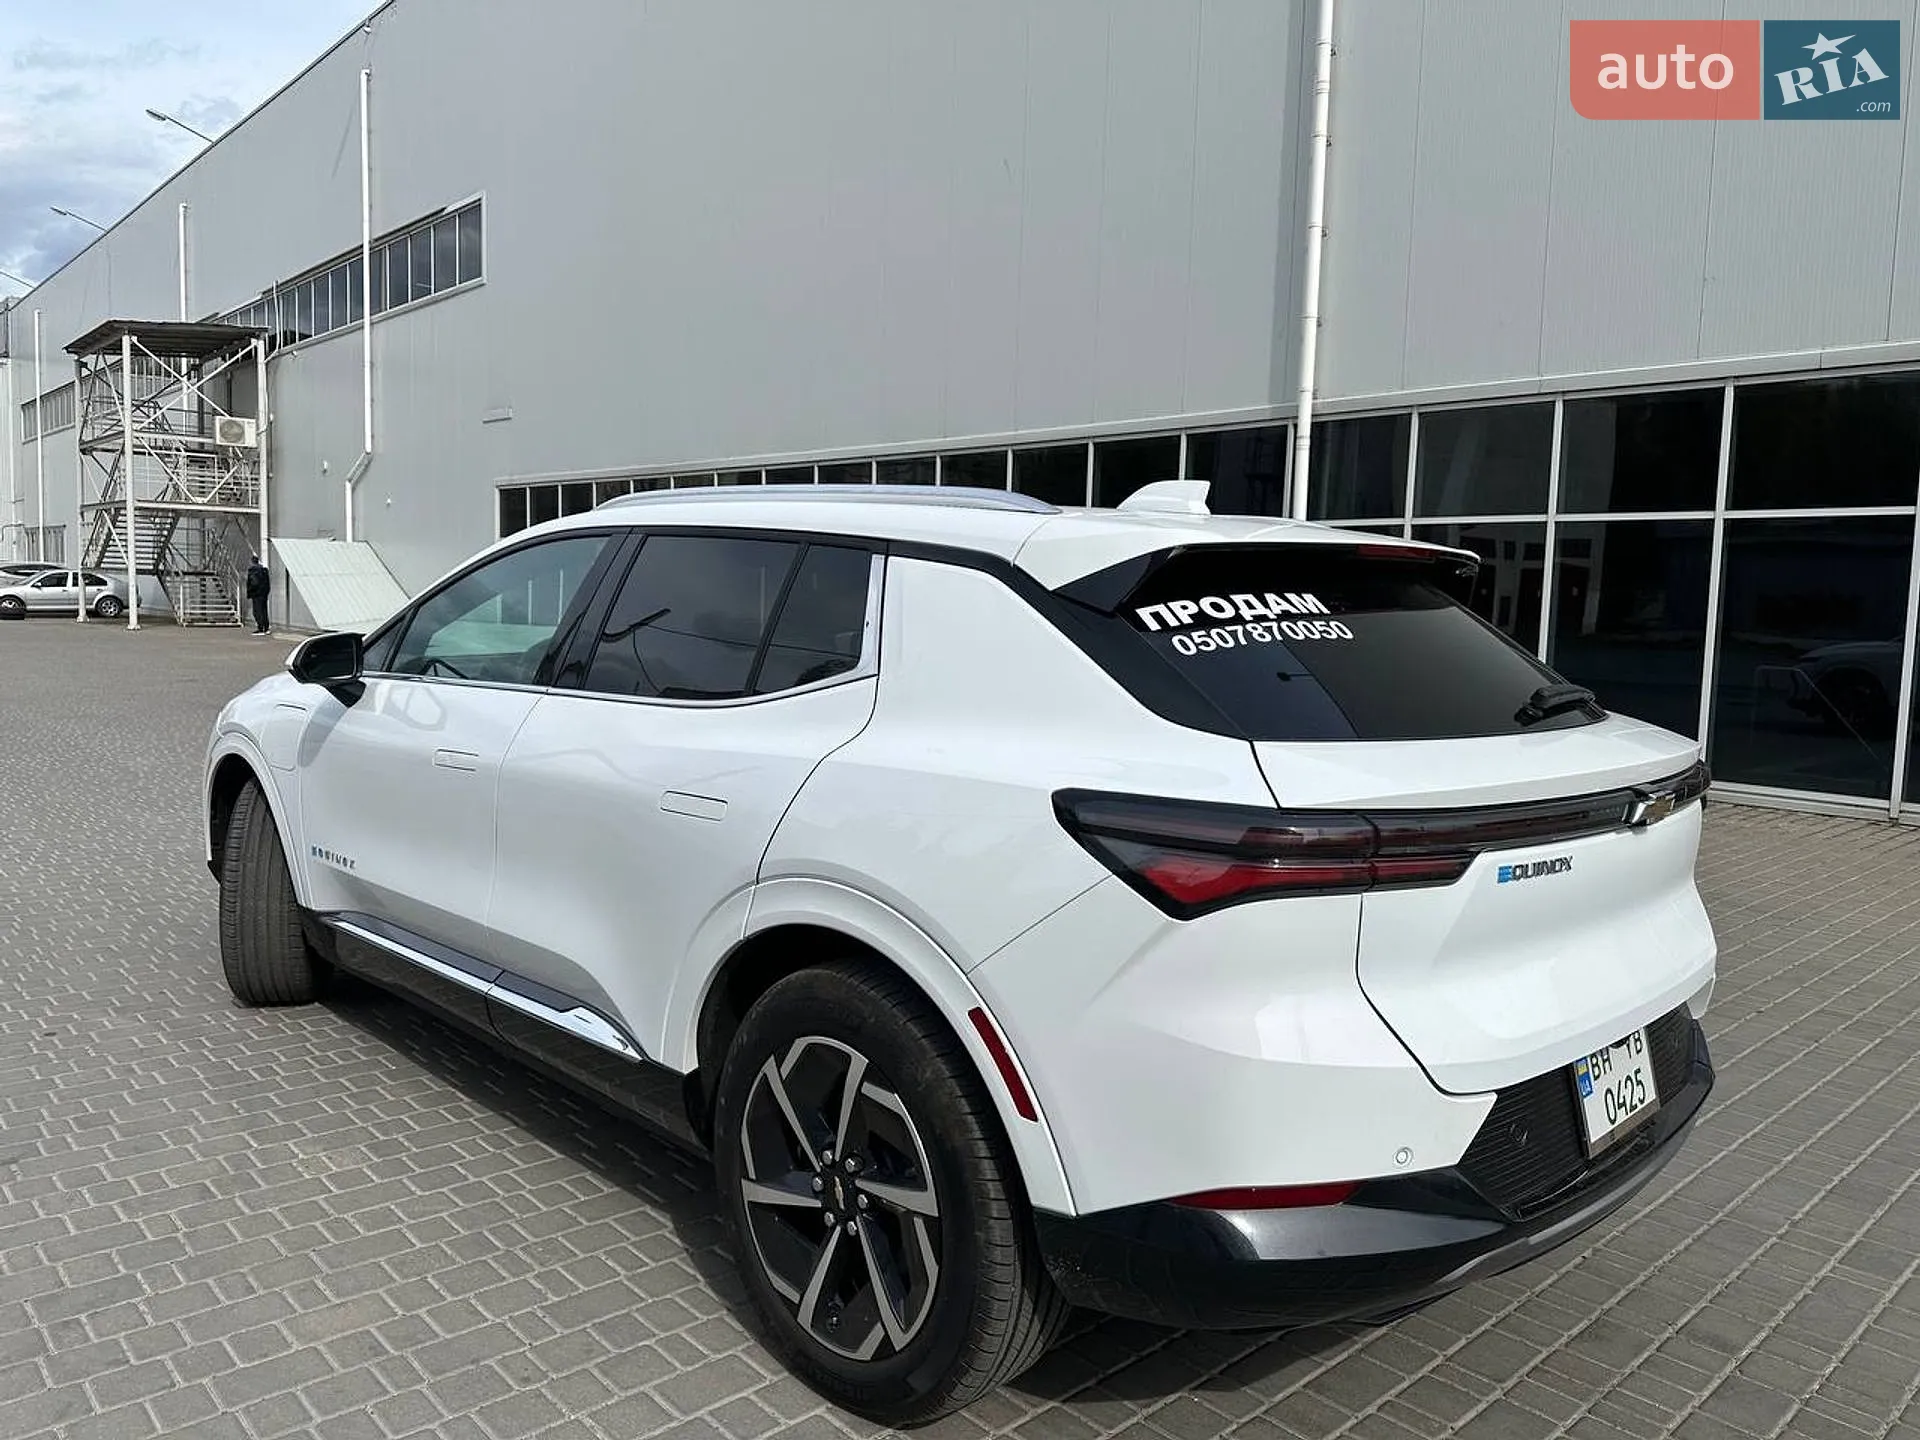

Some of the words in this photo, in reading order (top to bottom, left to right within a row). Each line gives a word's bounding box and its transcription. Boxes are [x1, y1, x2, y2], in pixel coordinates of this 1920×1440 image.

[1135, 592, 1332, 632] ПРОДАМ
[1171, 620, 1354, 656] 0507870050
[1497, 855, 1573, 883] EQUINOX
[1604, 1067, 1647, 1125] 0425
